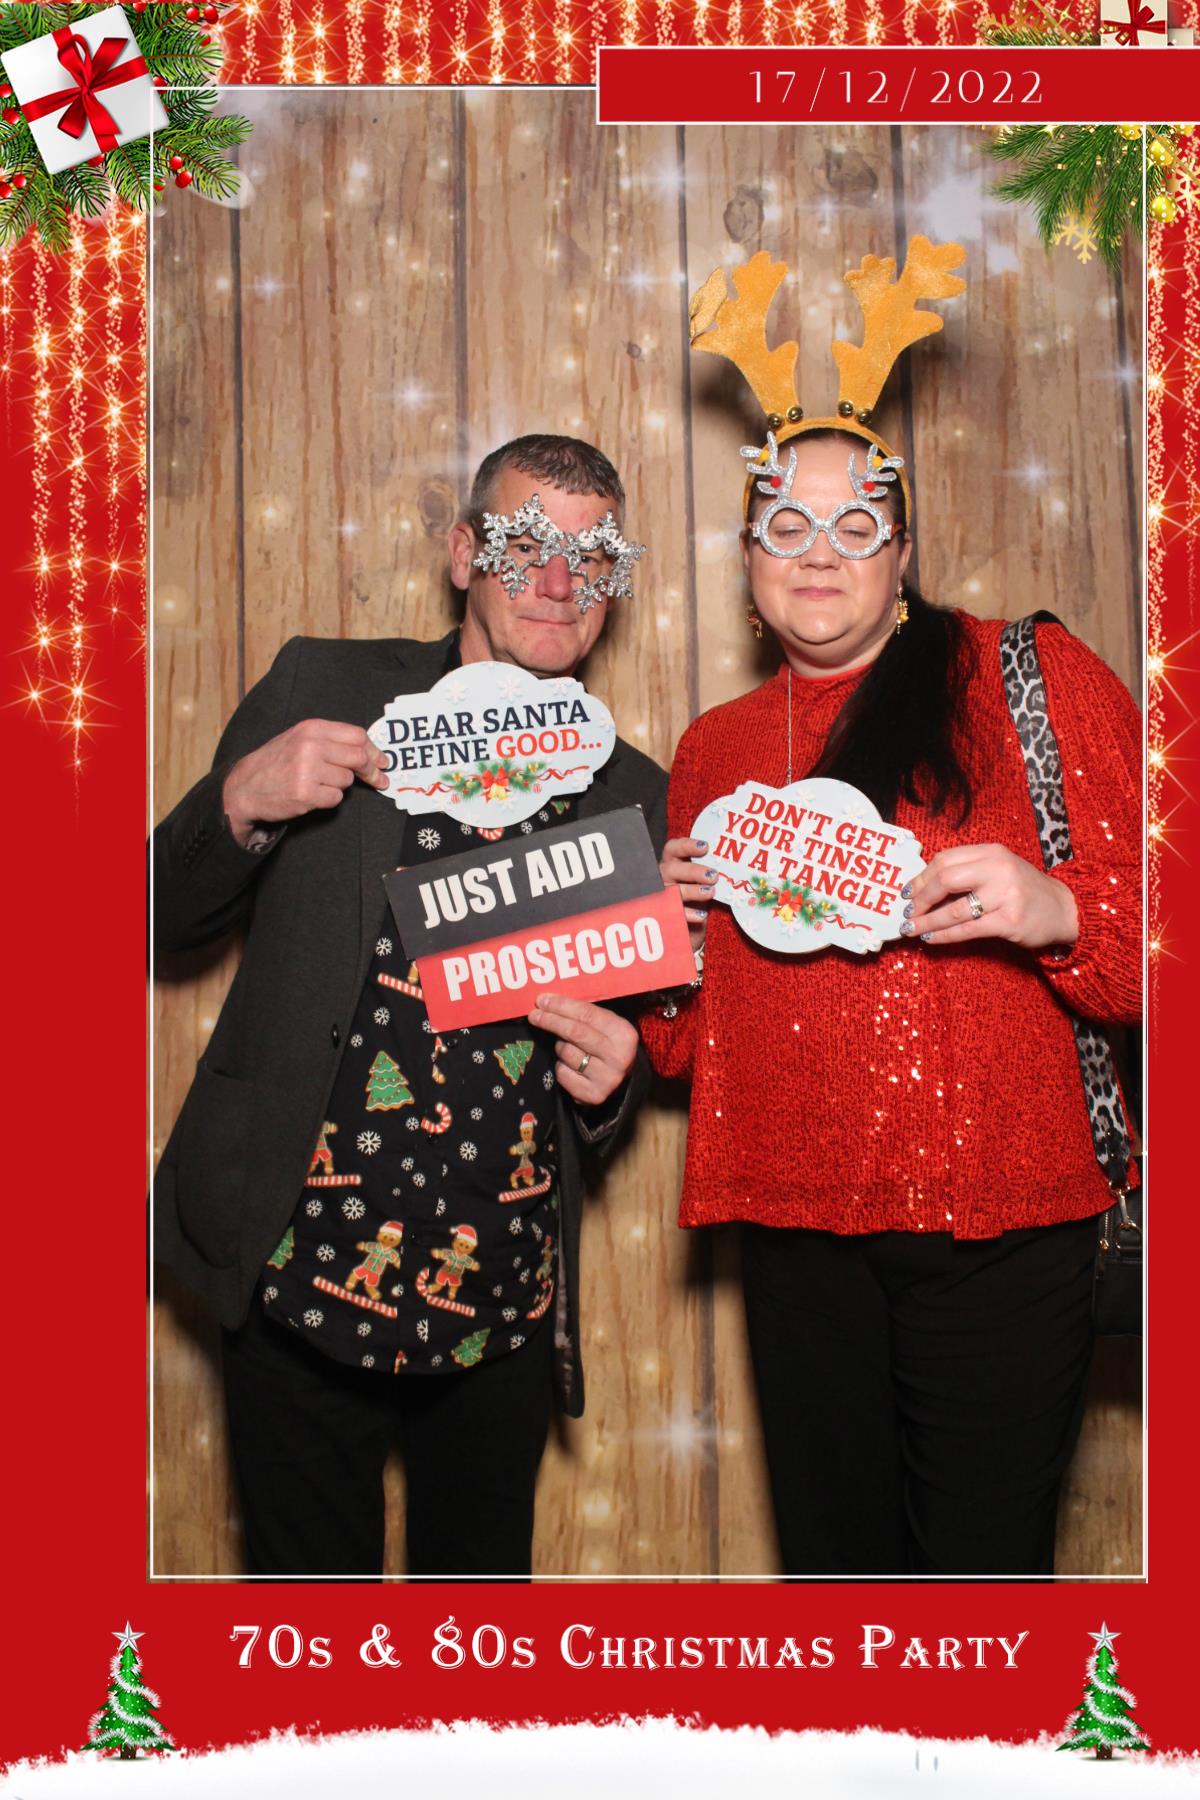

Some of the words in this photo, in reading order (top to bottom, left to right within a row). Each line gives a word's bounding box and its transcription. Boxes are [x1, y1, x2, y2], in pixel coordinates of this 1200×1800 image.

[380, 738, 490, 772] DEFINE
[495, 728, 602, 759] GOOD...
[386, 711, 477, 744] DEAR
[483, 699, 591, 734] SANTA
[725, 811, 796, 853] YOUR
[803, 837, 904, 892] TINSEL
[745, 793, 833, 836] DON'T
[835, 822, 898, 858] GET
[418, 858, 517, 929] JUST
[525, 832, 615, 898] ADD
[713, 835, 748, 863] IN
[748, 849, 770, 873] A
[778, 857, 897, 916] TANGLE
[442, 917, 664, 1002] PROSECCO
